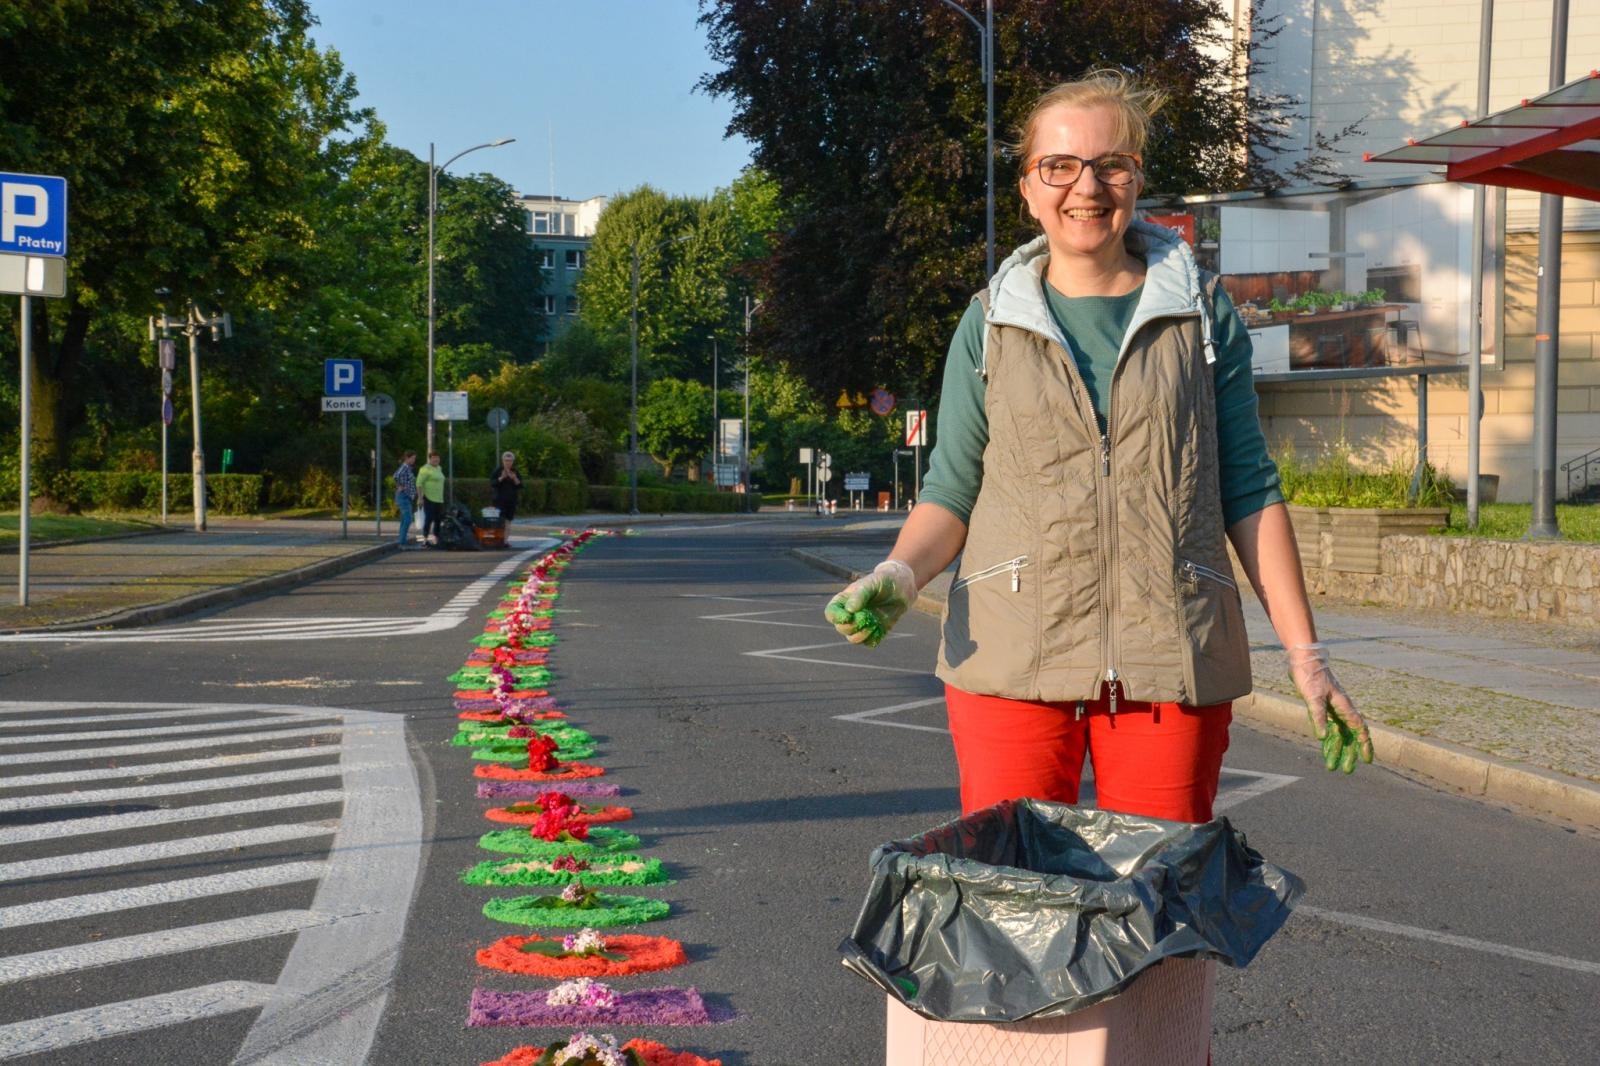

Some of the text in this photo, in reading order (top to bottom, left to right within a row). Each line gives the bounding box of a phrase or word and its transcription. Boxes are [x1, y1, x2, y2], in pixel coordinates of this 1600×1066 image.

[2, 182, 49, 242] P
[18, 236, 62, 252] Płatny
[334, 364, 354, 391] P
[326, 400, 361, 409] Koniec
